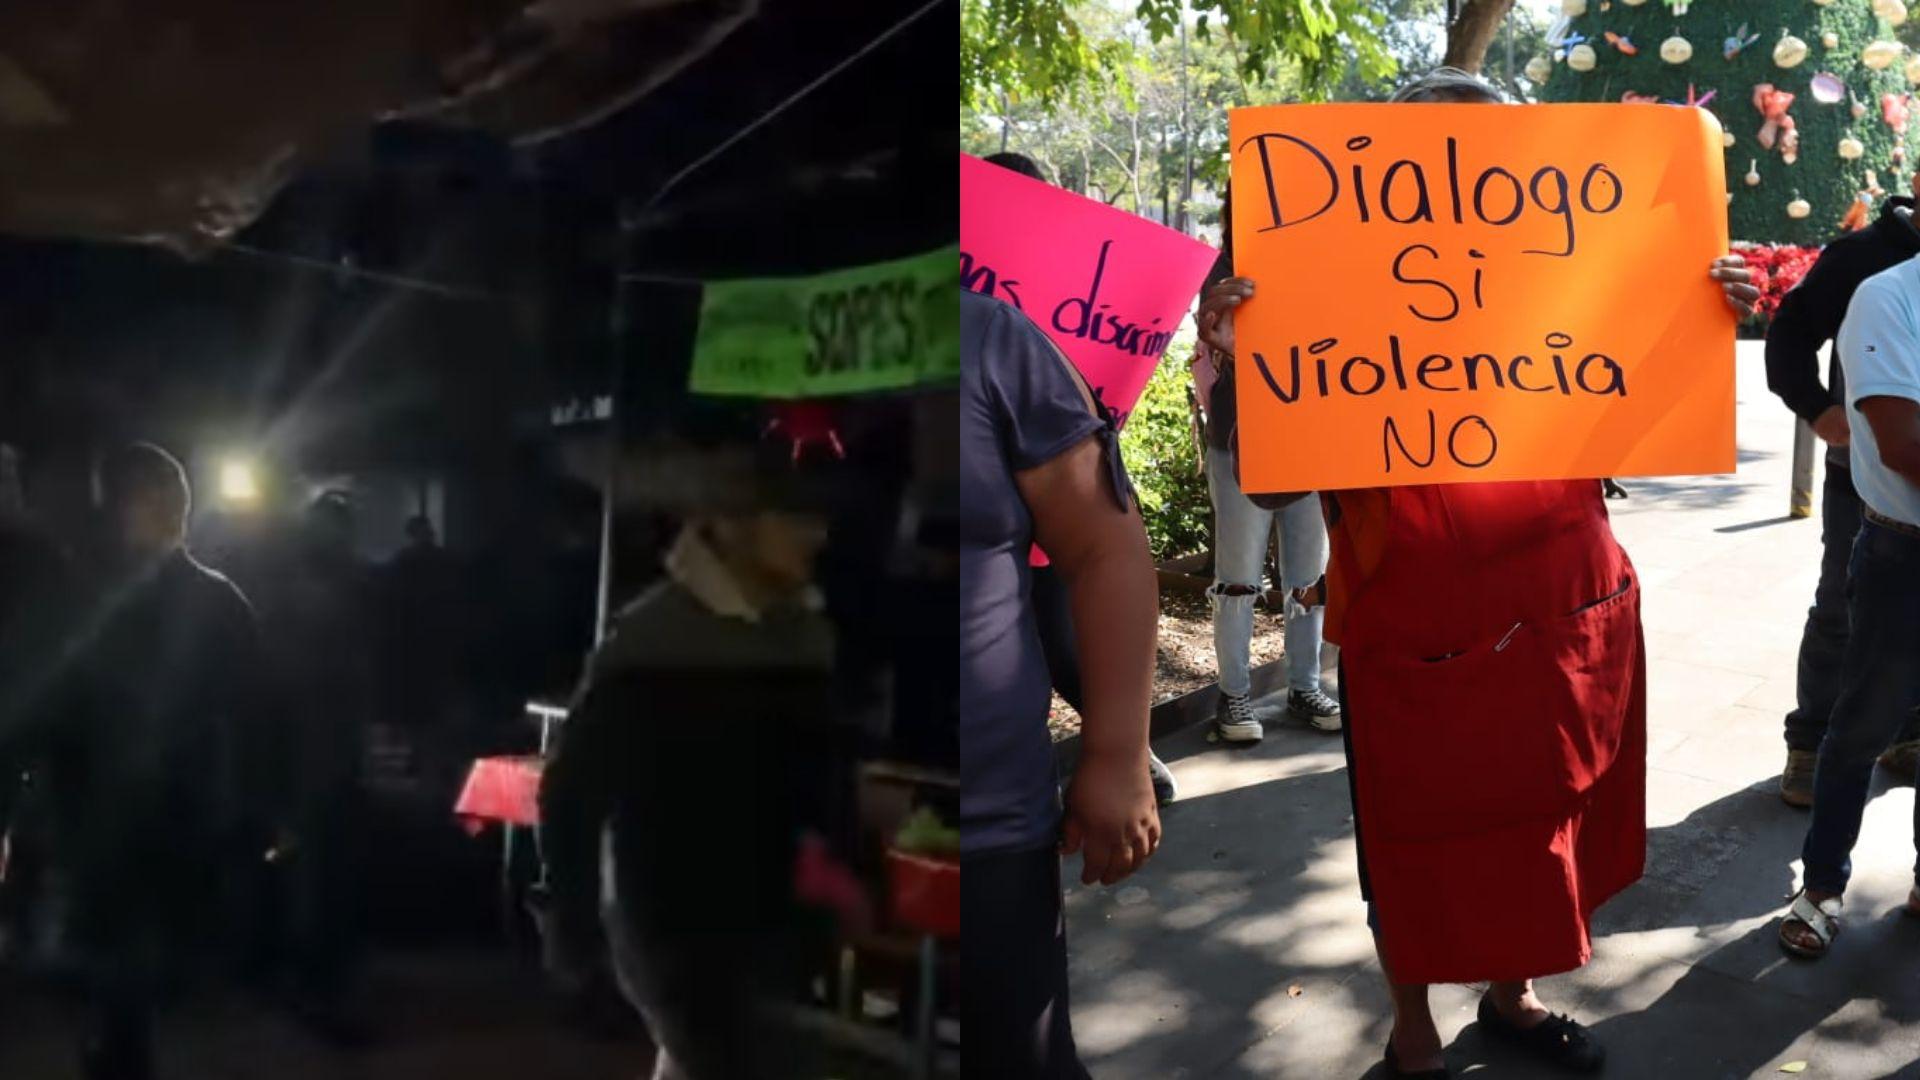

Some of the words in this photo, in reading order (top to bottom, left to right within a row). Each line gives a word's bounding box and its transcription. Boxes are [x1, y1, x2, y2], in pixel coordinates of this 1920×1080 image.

[1239, 132, 1623, 256] Dialogo
[1393, 244, 1486, 321] Si
[1382, 409, 1498, 473] NO
